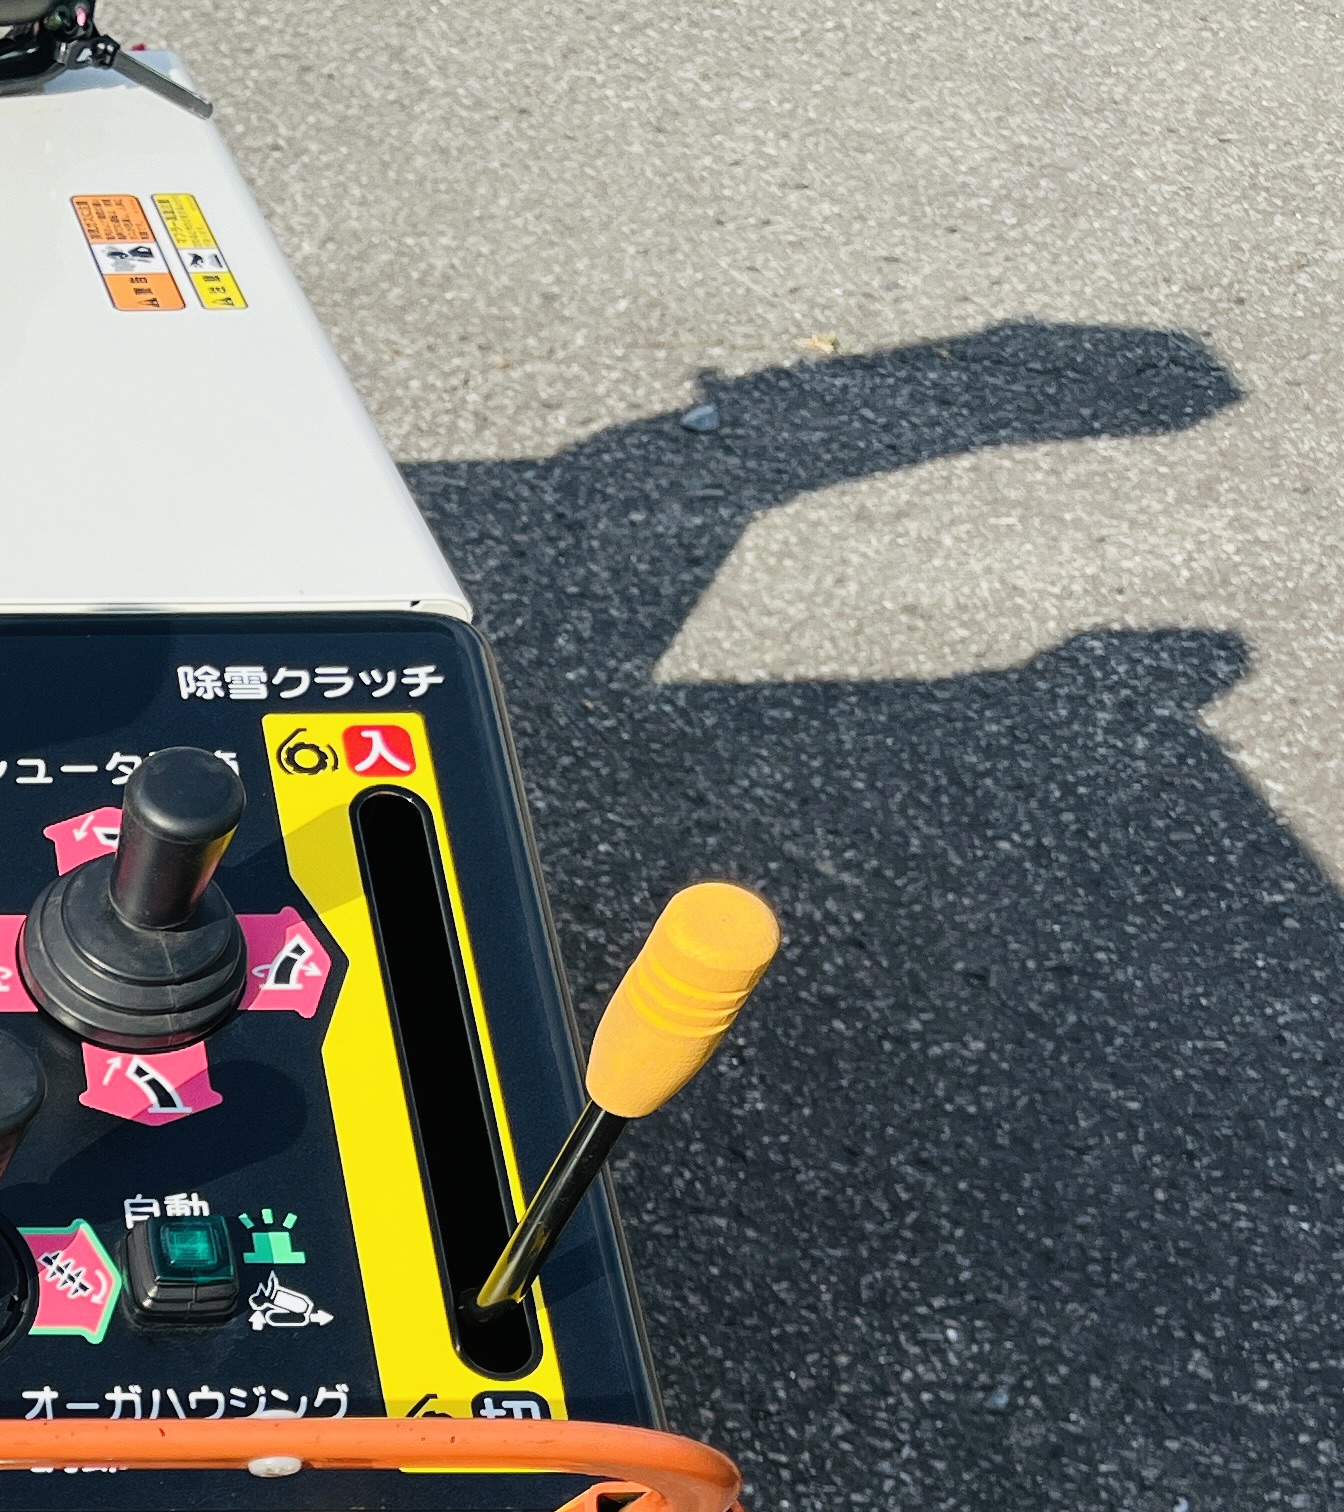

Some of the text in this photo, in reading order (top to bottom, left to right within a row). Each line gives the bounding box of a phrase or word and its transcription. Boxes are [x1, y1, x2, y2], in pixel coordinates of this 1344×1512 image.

[177, 665, 446, 700] 除雪クラッチ
[355, 730, 411, 772] 入
[124, 1193, 210, 1229] 自動
[21, 1384, 349, 1420] オーガハウジング
